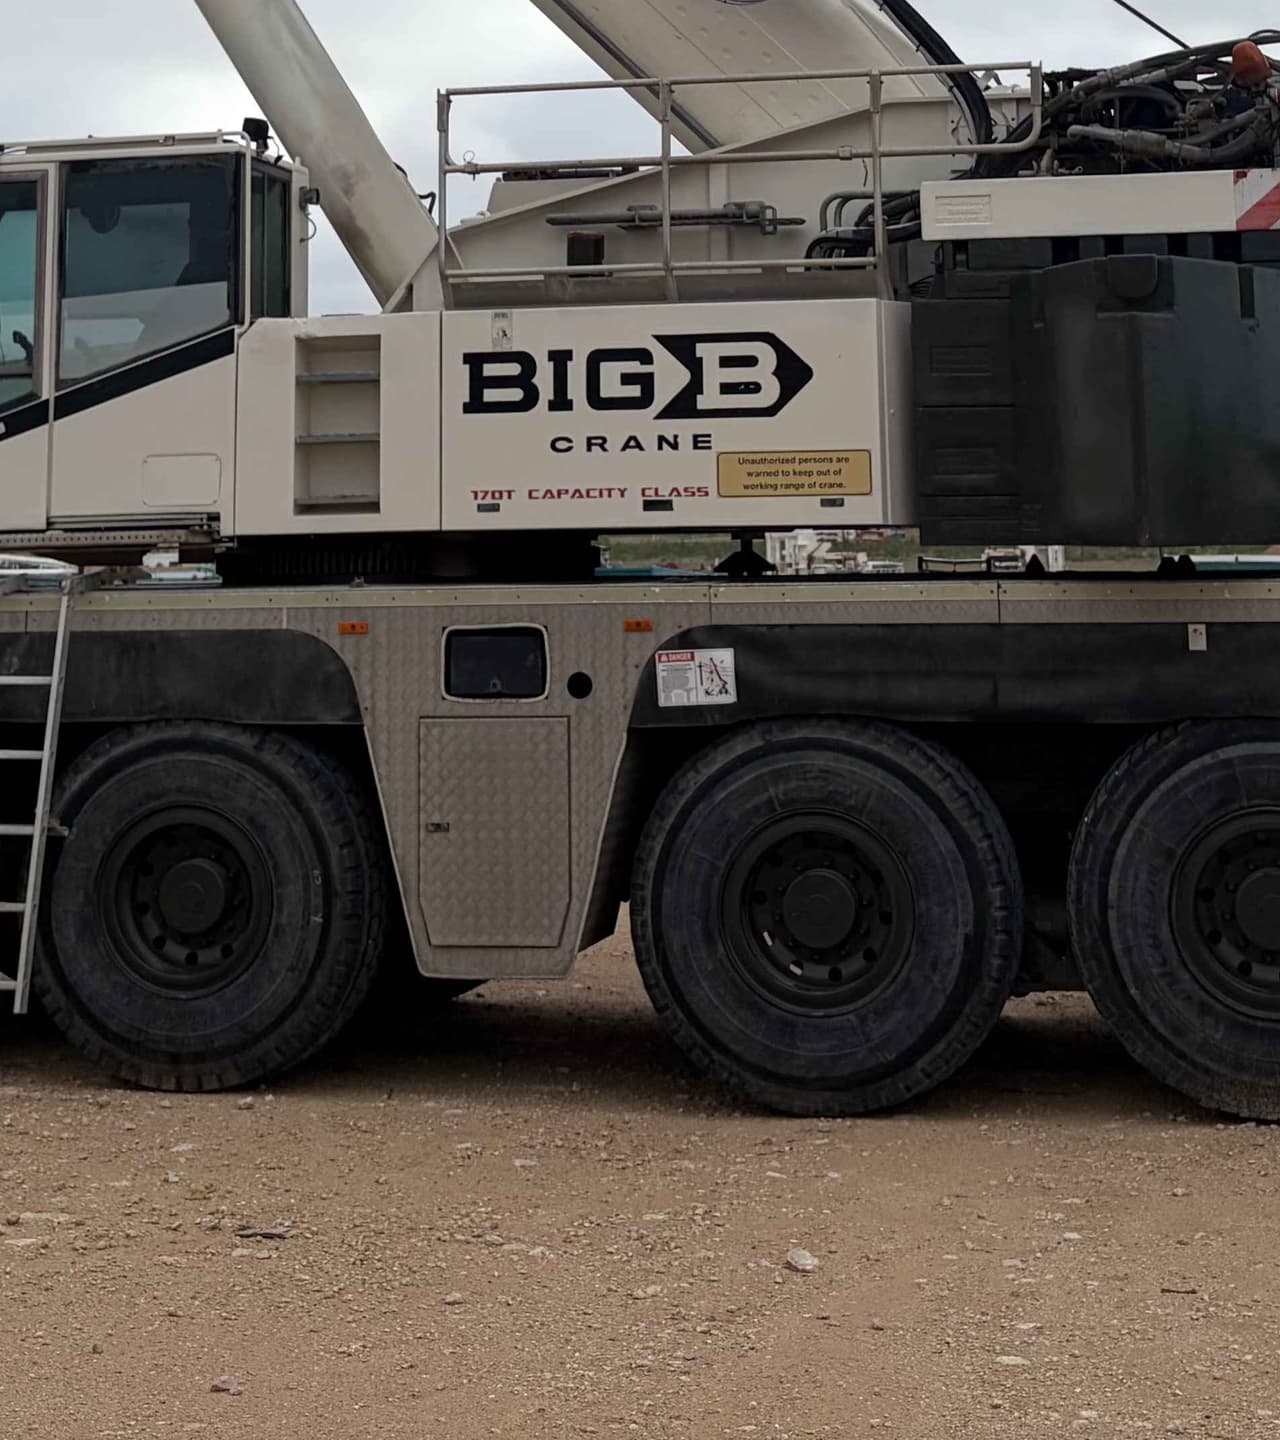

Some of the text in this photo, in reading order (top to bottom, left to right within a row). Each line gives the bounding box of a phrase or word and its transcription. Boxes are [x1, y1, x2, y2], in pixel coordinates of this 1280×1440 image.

[462, 340, 782, 415] BIG B
[549, 433, 713, 453] CRANE
[737, 456, 850, 466] Unauthorized persons are
[746, 468, 842, 478] warned to keep out of
[743, 481, 778, 491] working
[780, 482, 805, 491] range
[807, 481, 817, 489] of
[470, 486, 710, 501] 170T CAPACITY CLASS
[668, 652, 692, 661] DANGER
